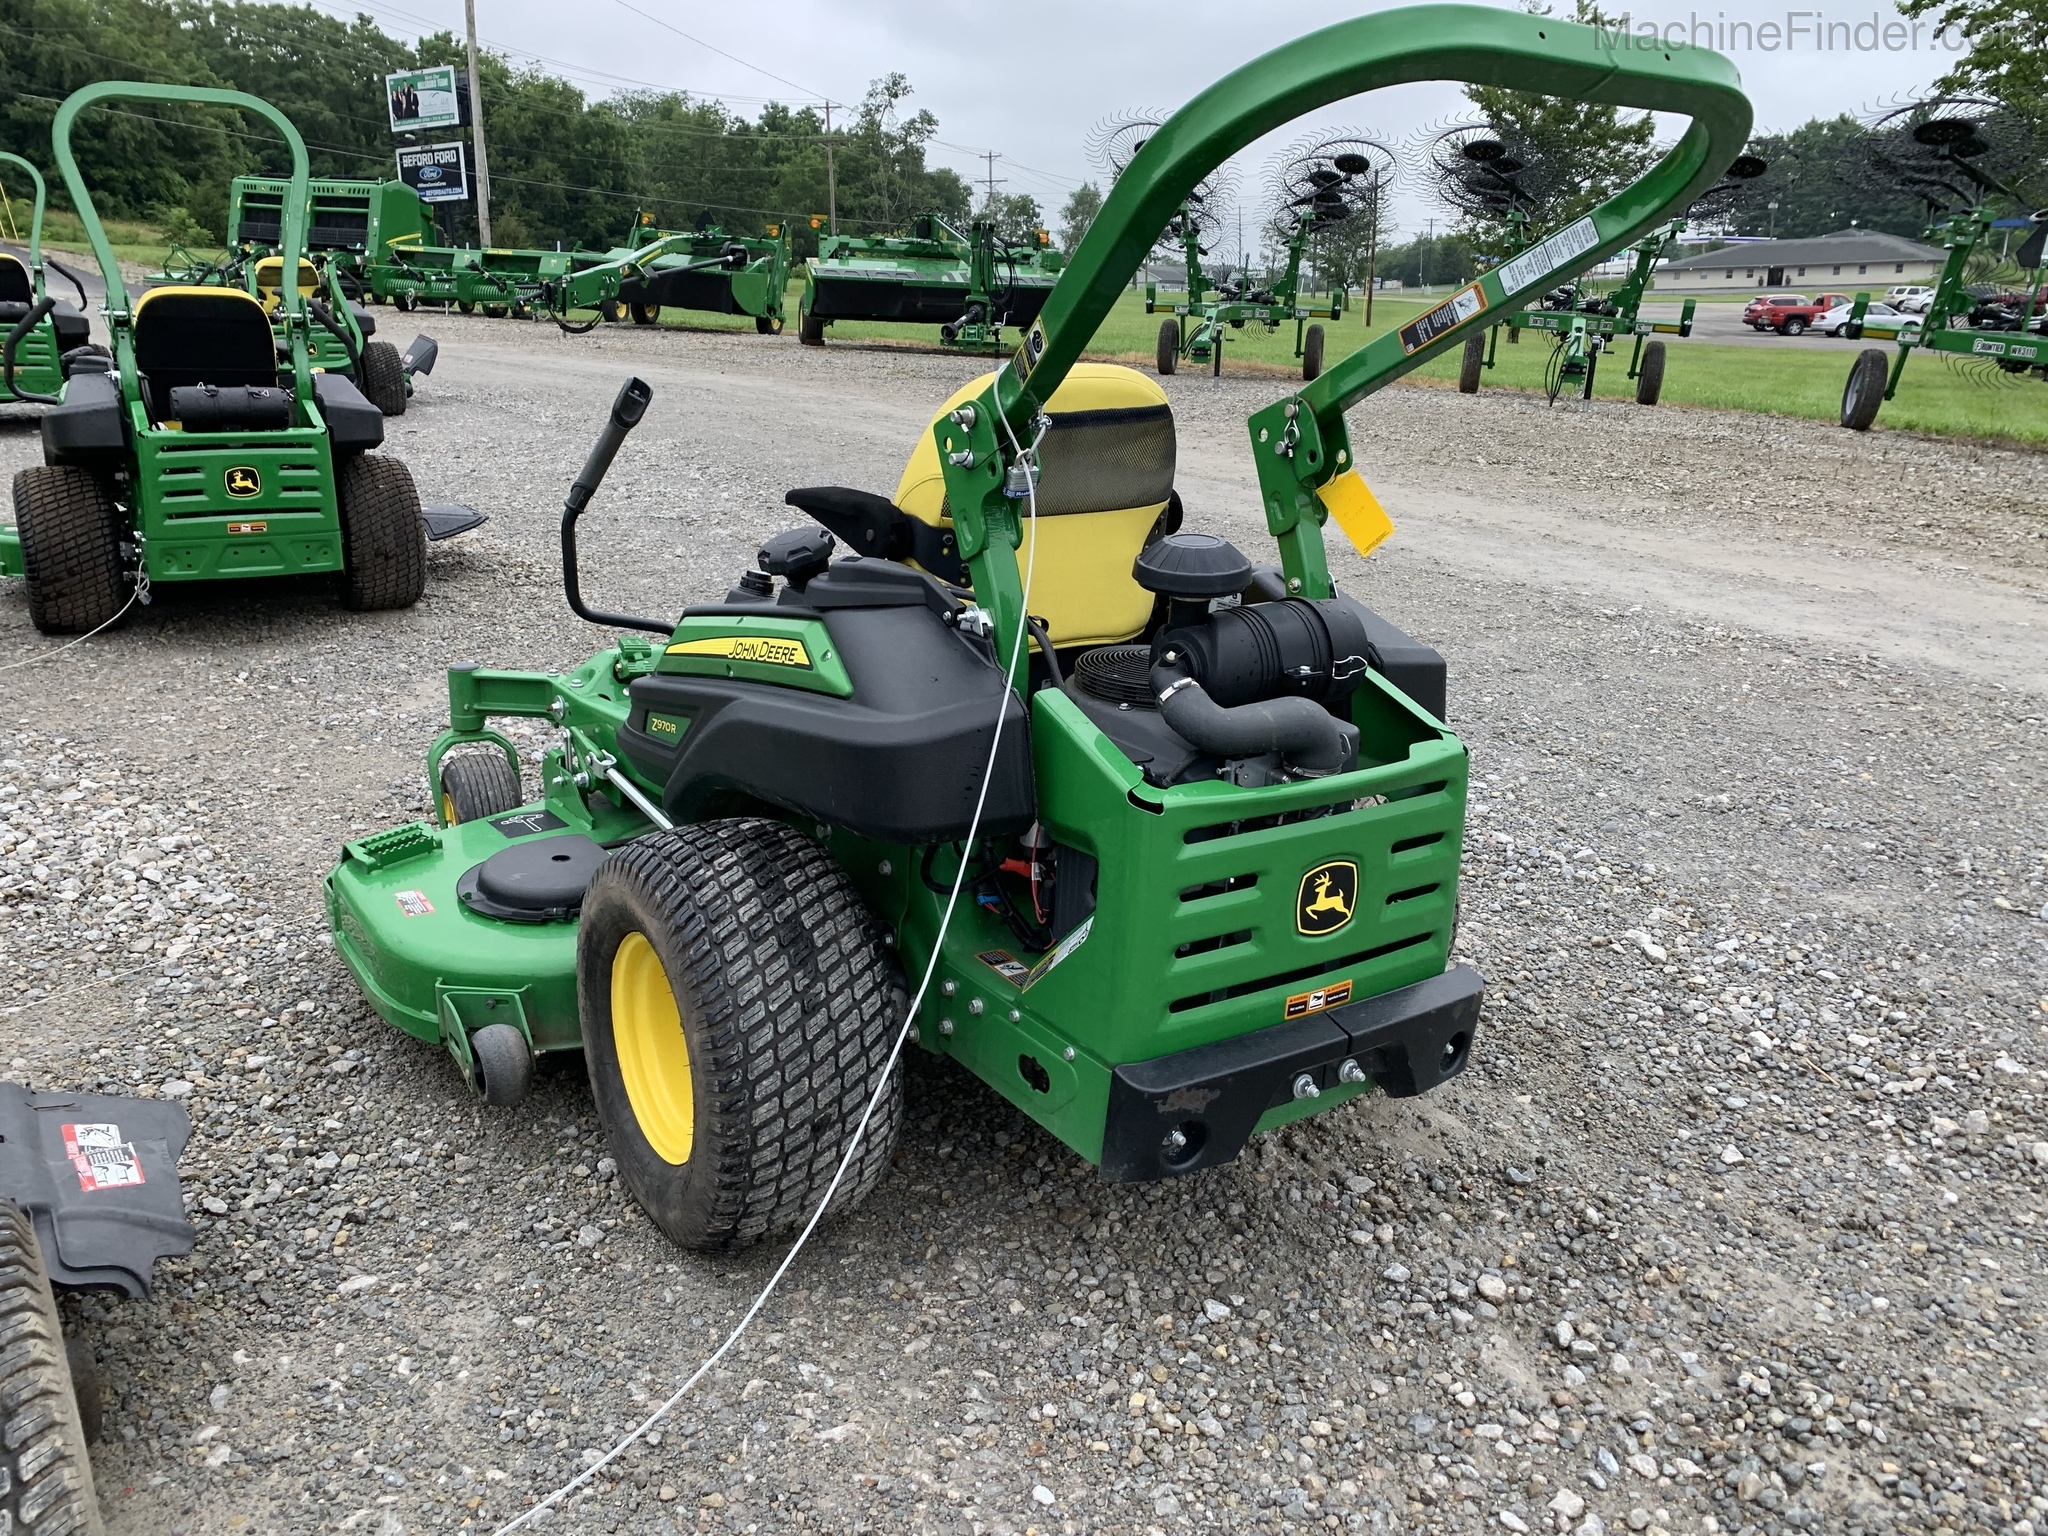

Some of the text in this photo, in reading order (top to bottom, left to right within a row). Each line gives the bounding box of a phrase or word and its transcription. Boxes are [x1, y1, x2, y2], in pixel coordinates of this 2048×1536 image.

[403, 150, 456, 167] BEFORD FORD
[424, 168, 437, 178] Ford
[426, 188, 462, 196] BEFORDAUTO.COM
[1974, 339, 2004, 353] FRONTIER
[728, 639, 798, 662] JOHN DEERE
[651, 718, 677, 734] Z970R
